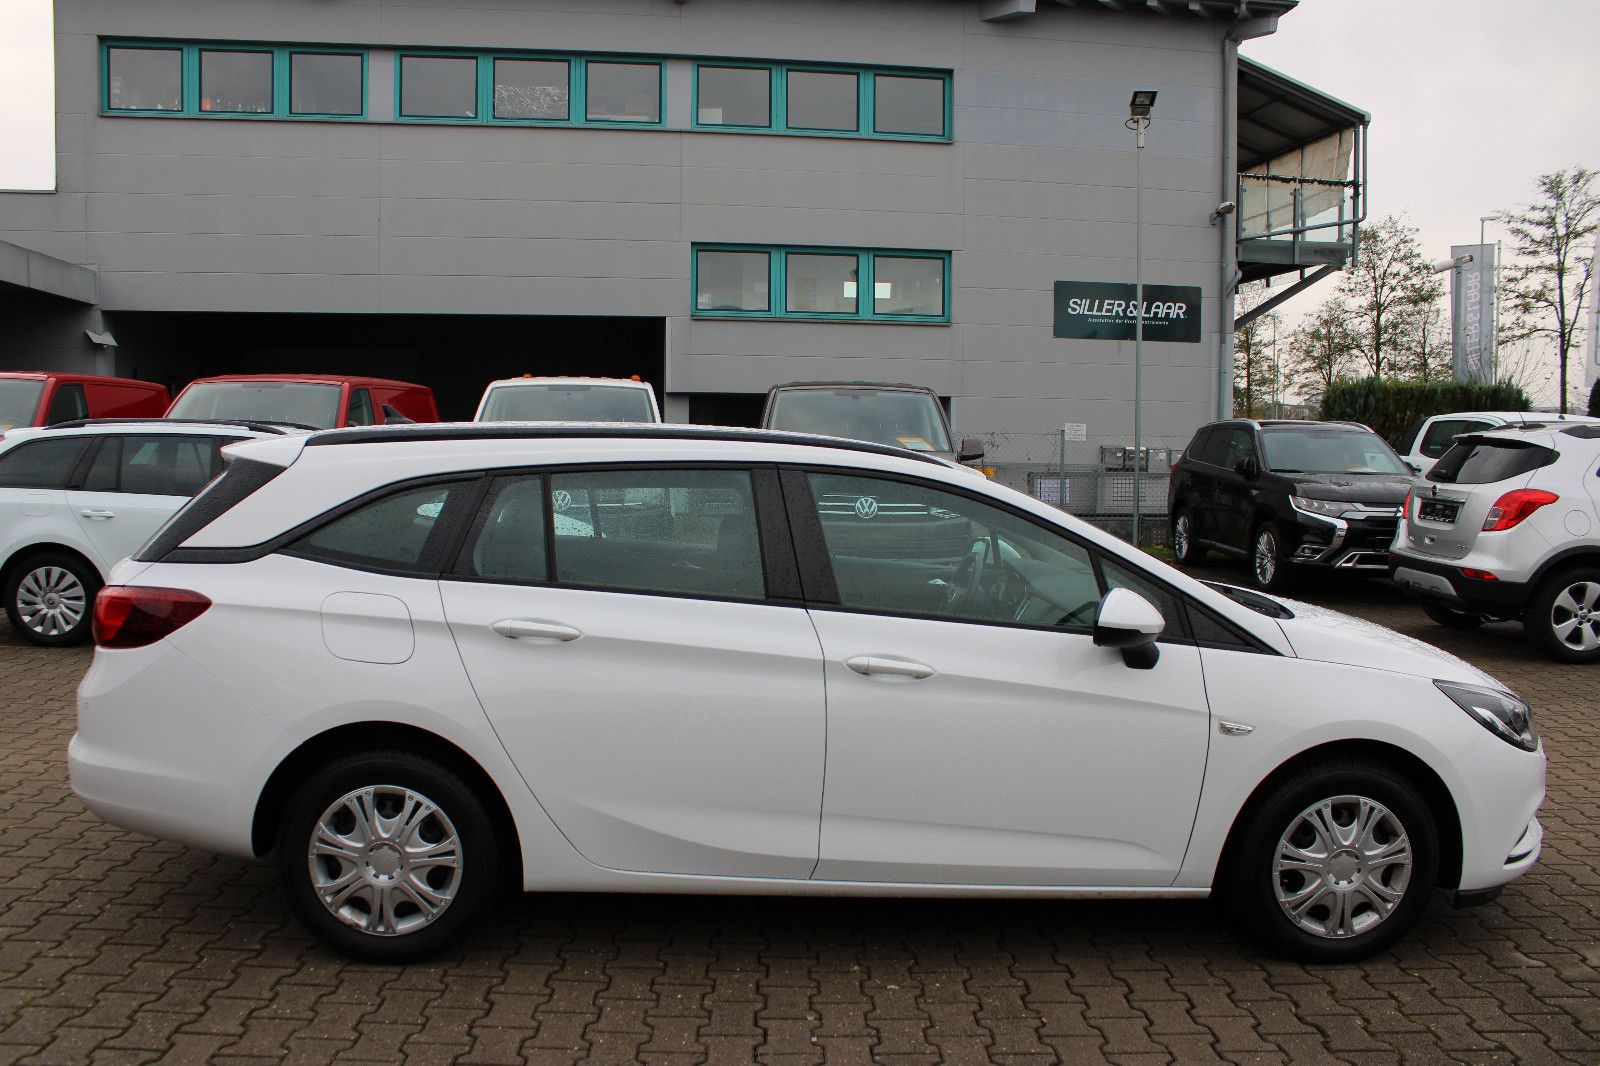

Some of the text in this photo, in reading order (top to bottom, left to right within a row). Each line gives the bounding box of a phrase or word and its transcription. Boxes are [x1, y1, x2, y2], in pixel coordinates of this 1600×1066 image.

[1068, 298, 1125, 316] SILLER
[1141, 301, 1187, 319] LAAR
[855, 497, 877, 518] VW
